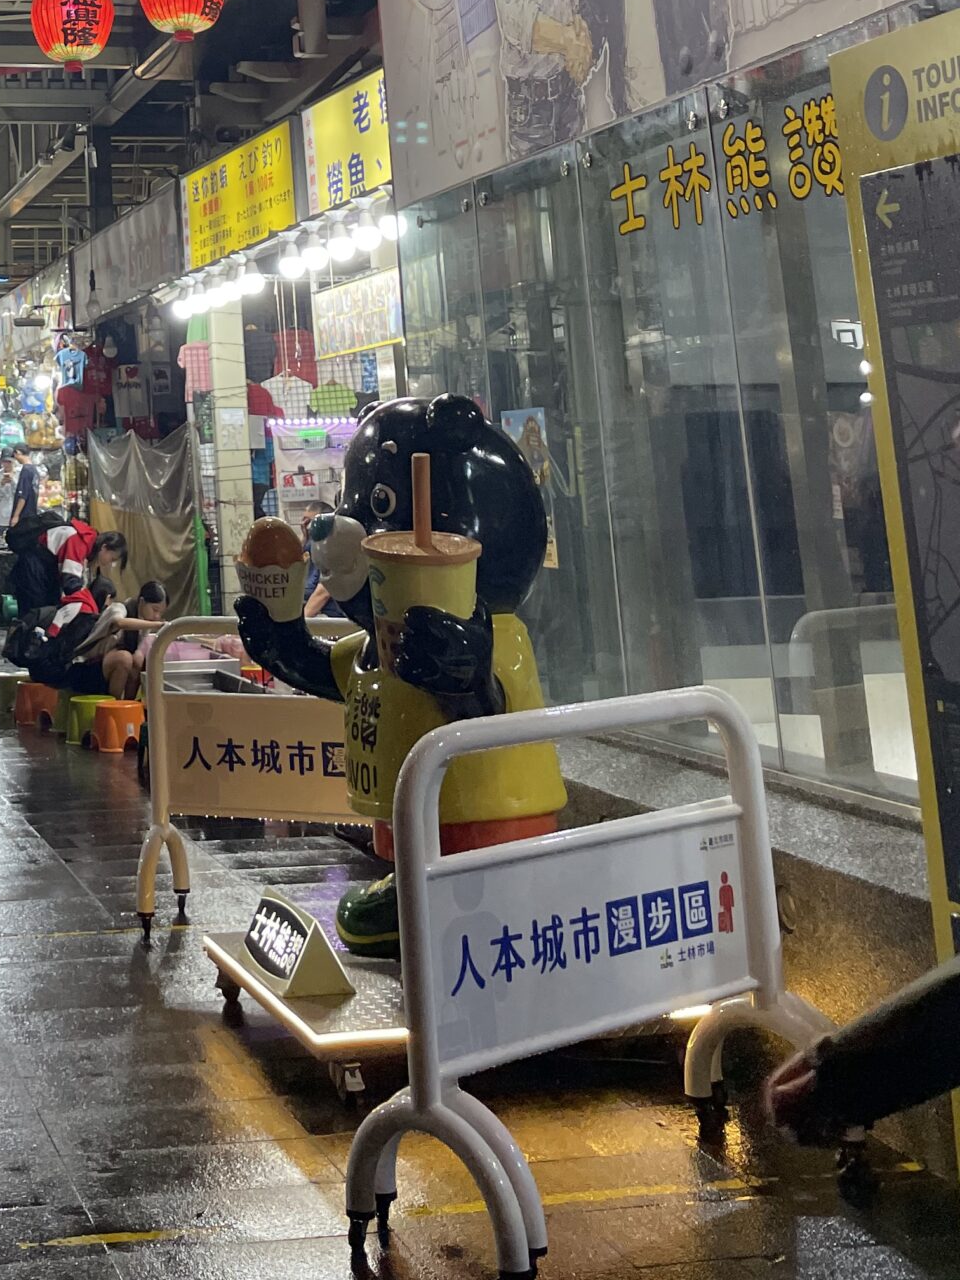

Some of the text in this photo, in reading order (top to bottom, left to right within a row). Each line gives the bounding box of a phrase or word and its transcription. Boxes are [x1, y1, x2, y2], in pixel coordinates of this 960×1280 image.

[912, 55, 960, 92] TOU
[238, 137, 282, 181] えび釣り
[609, 92, 844, 236] 士林熊讚
[451, 881, 713, 997] 人本城市漫步區
[678, 940, 716, 962] 士林市場
